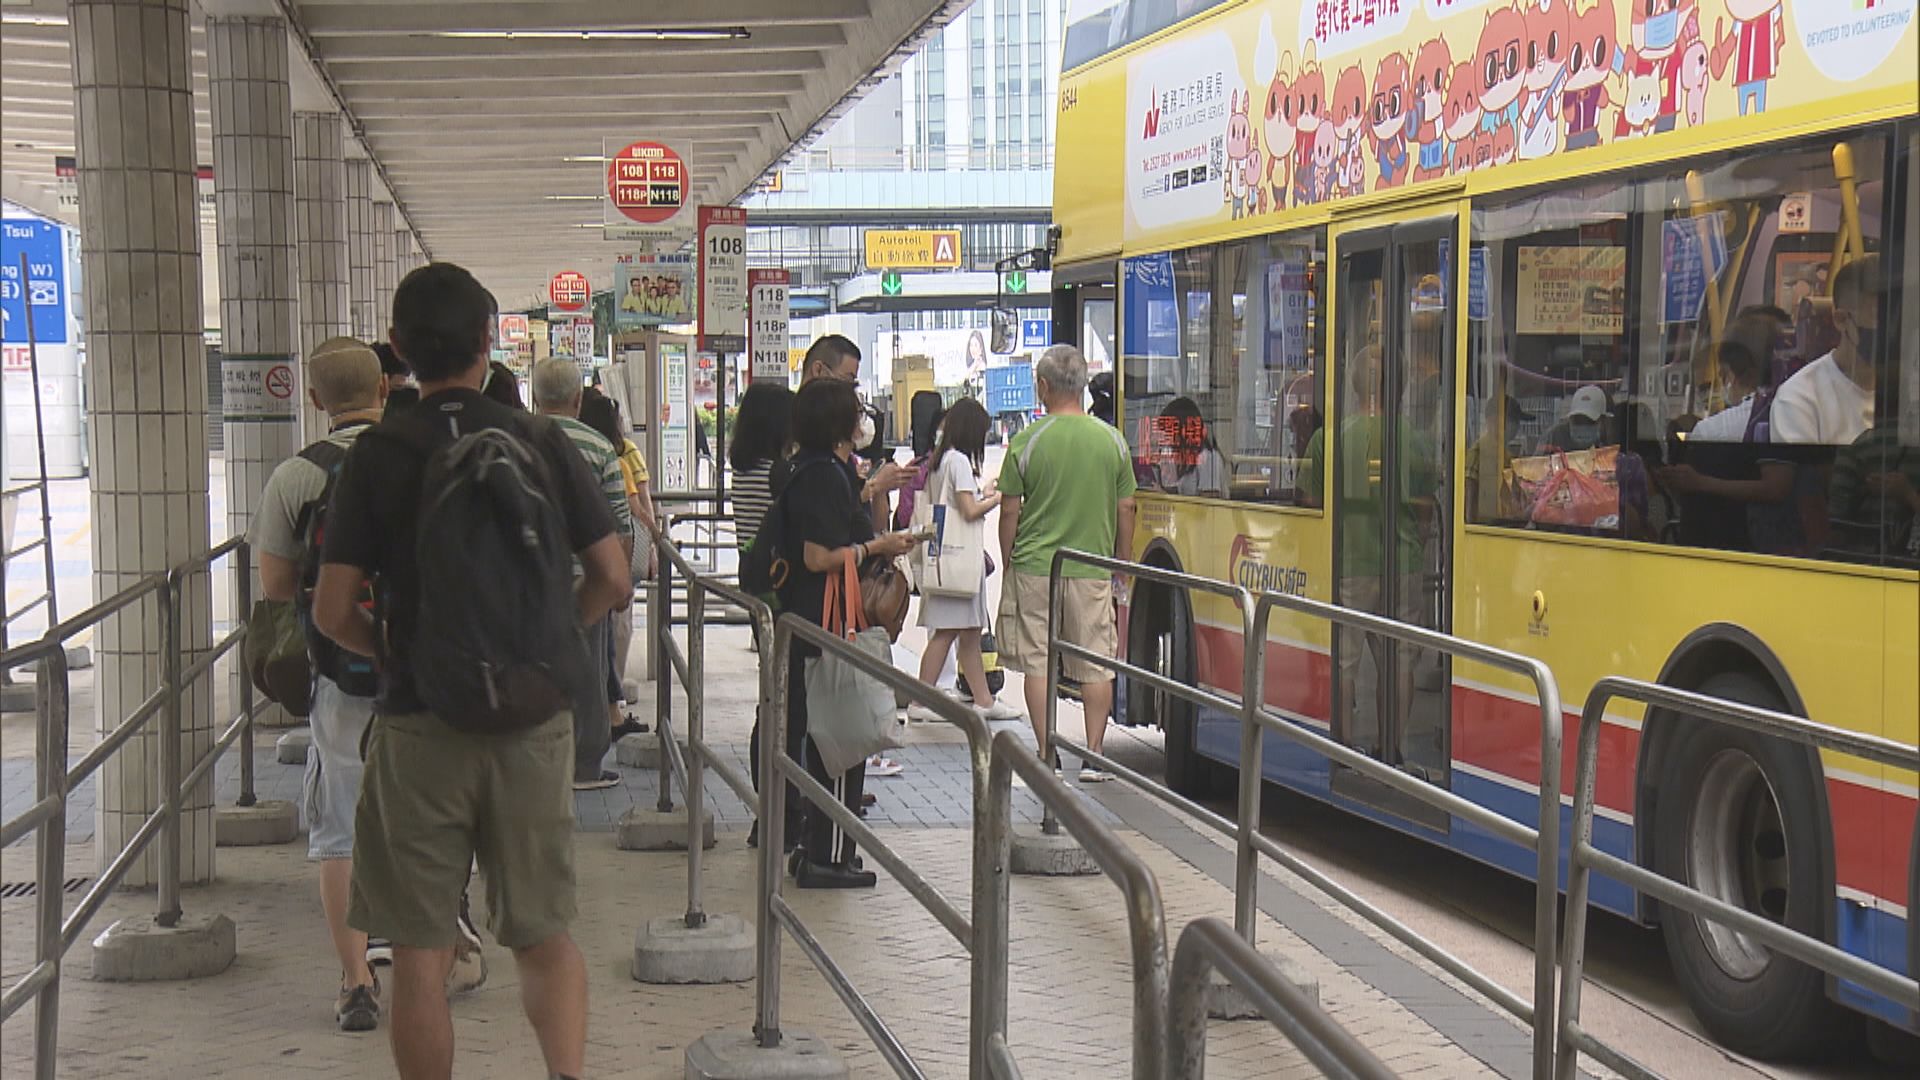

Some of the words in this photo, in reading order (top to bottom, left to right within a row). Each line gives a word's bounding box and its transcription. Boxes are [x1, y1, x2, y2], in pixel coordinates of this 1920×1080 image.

[1806, 26, 1839, 48] DEVOTED
[1841, 23, 1850, 38] TO
[1851, 8, 1910, 37] VOLUNTEERING
[622, 164, 643, 178] 108
[653, 165, 676, 178] 118
[619, 188, 647, 201] 118P
[650, 189, 680, 201] N118
[4, 224, 34, 238] Tsui
[709, 236, 743, 255] 108
[880, 235, 921, 245] Autotoll
[31, 264, 54, 278] W)
[758, 288, 784, 302] 118
[755, 319, 787, 333] 118P
[755, 350, 787, 363] N118
[1239, 559, 1284, 593] CITYBUS
